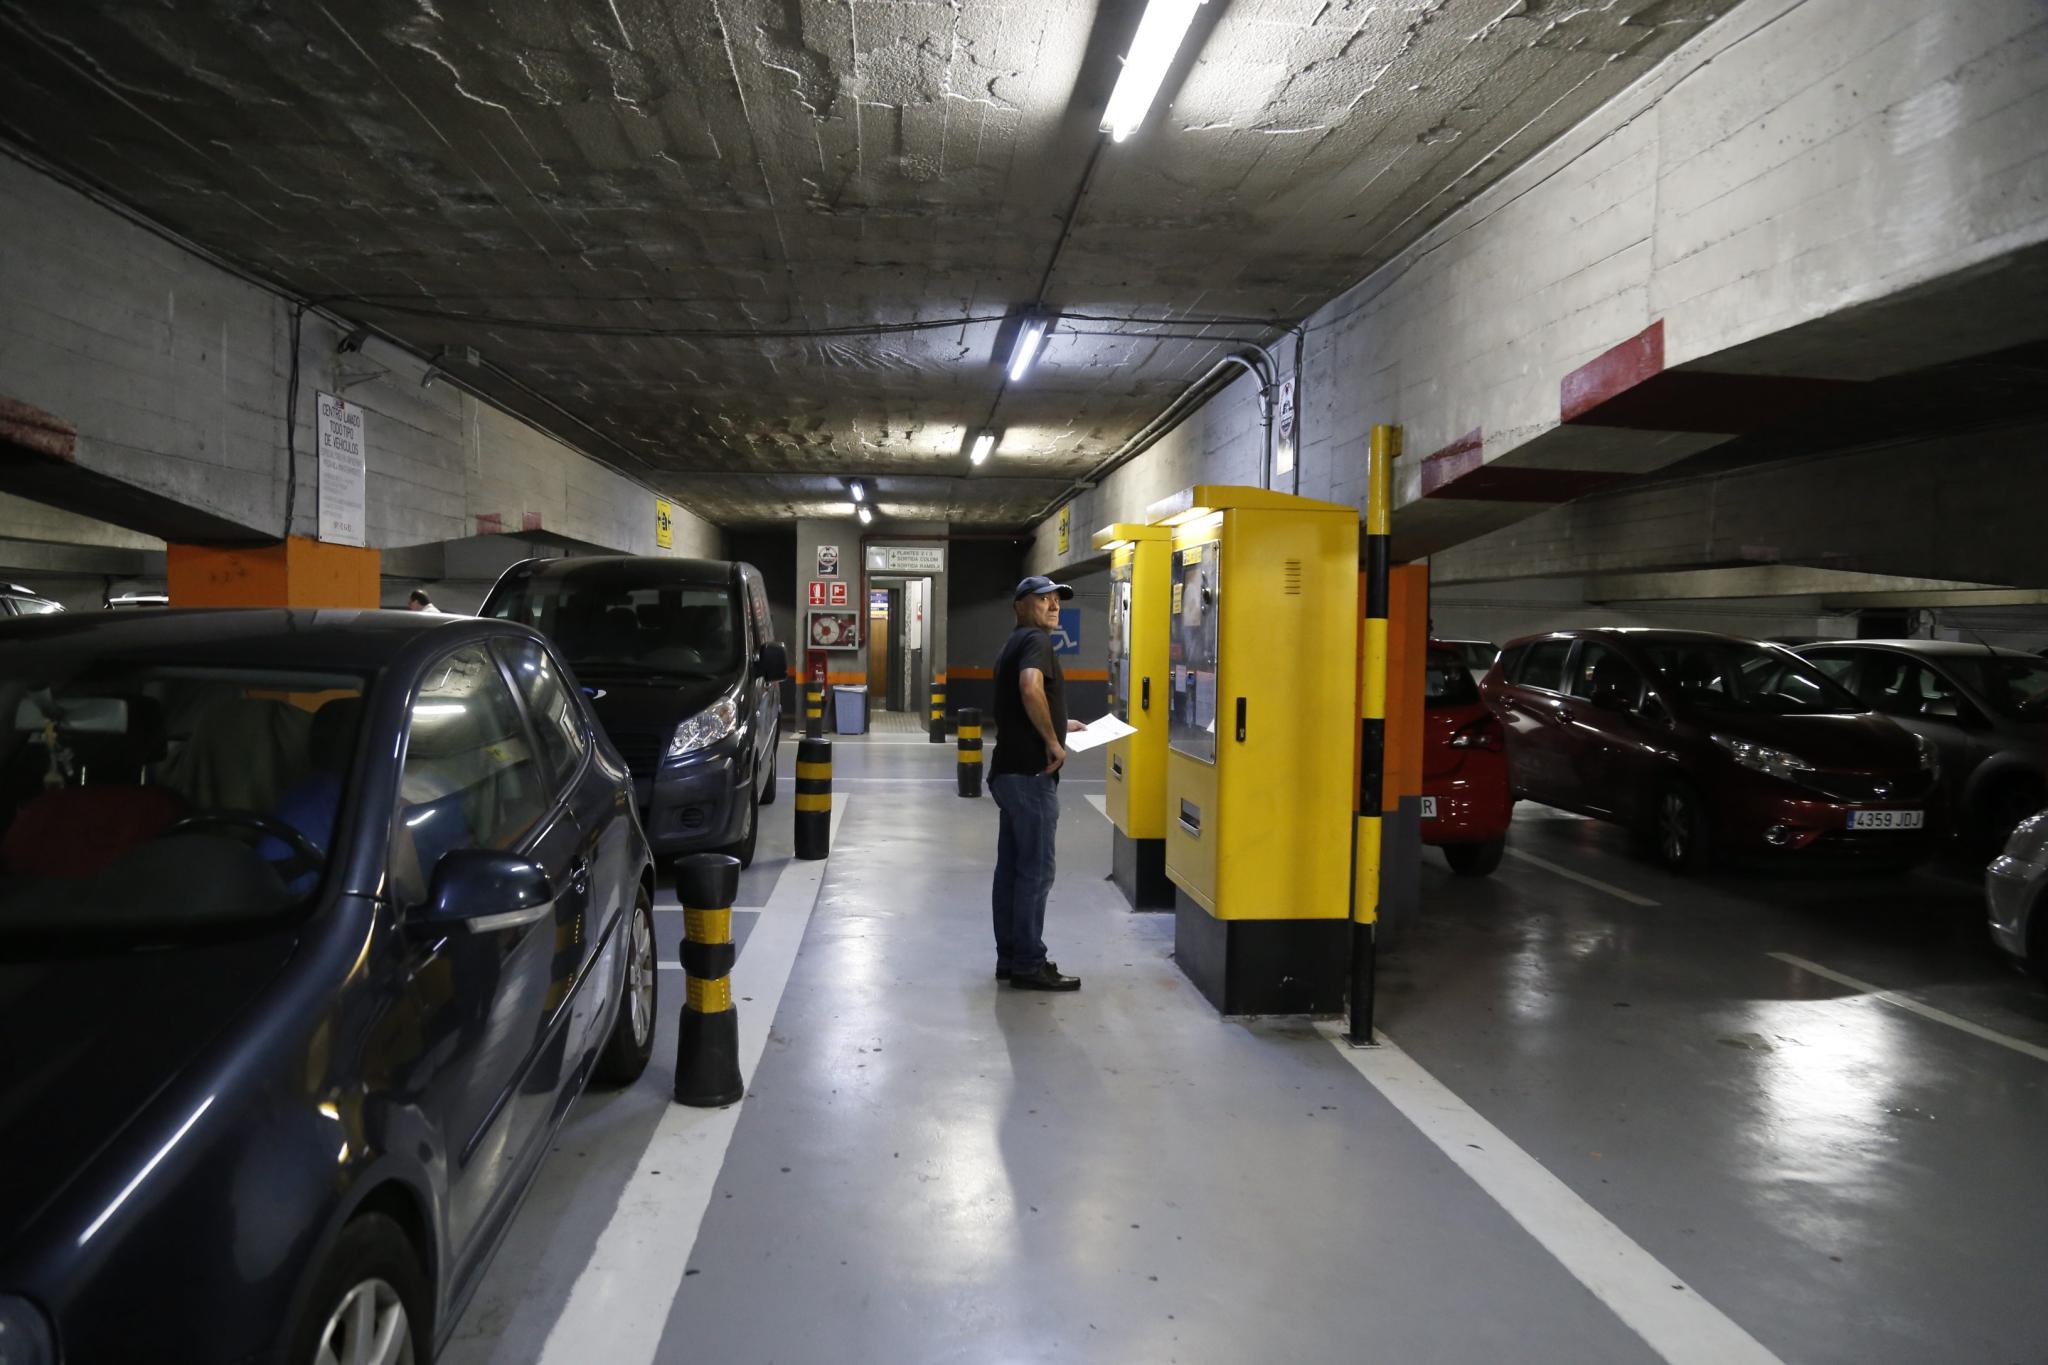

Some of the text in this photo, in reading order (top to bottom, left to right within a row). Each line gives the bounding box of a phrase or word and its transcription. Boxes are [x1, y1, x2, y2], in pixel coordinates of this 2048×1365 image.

[330, 420, 353, 440] TODO TIPO
[325, 433, 332, 447] DE
[1857, 812, 1921, 827] 4359 JDJ
